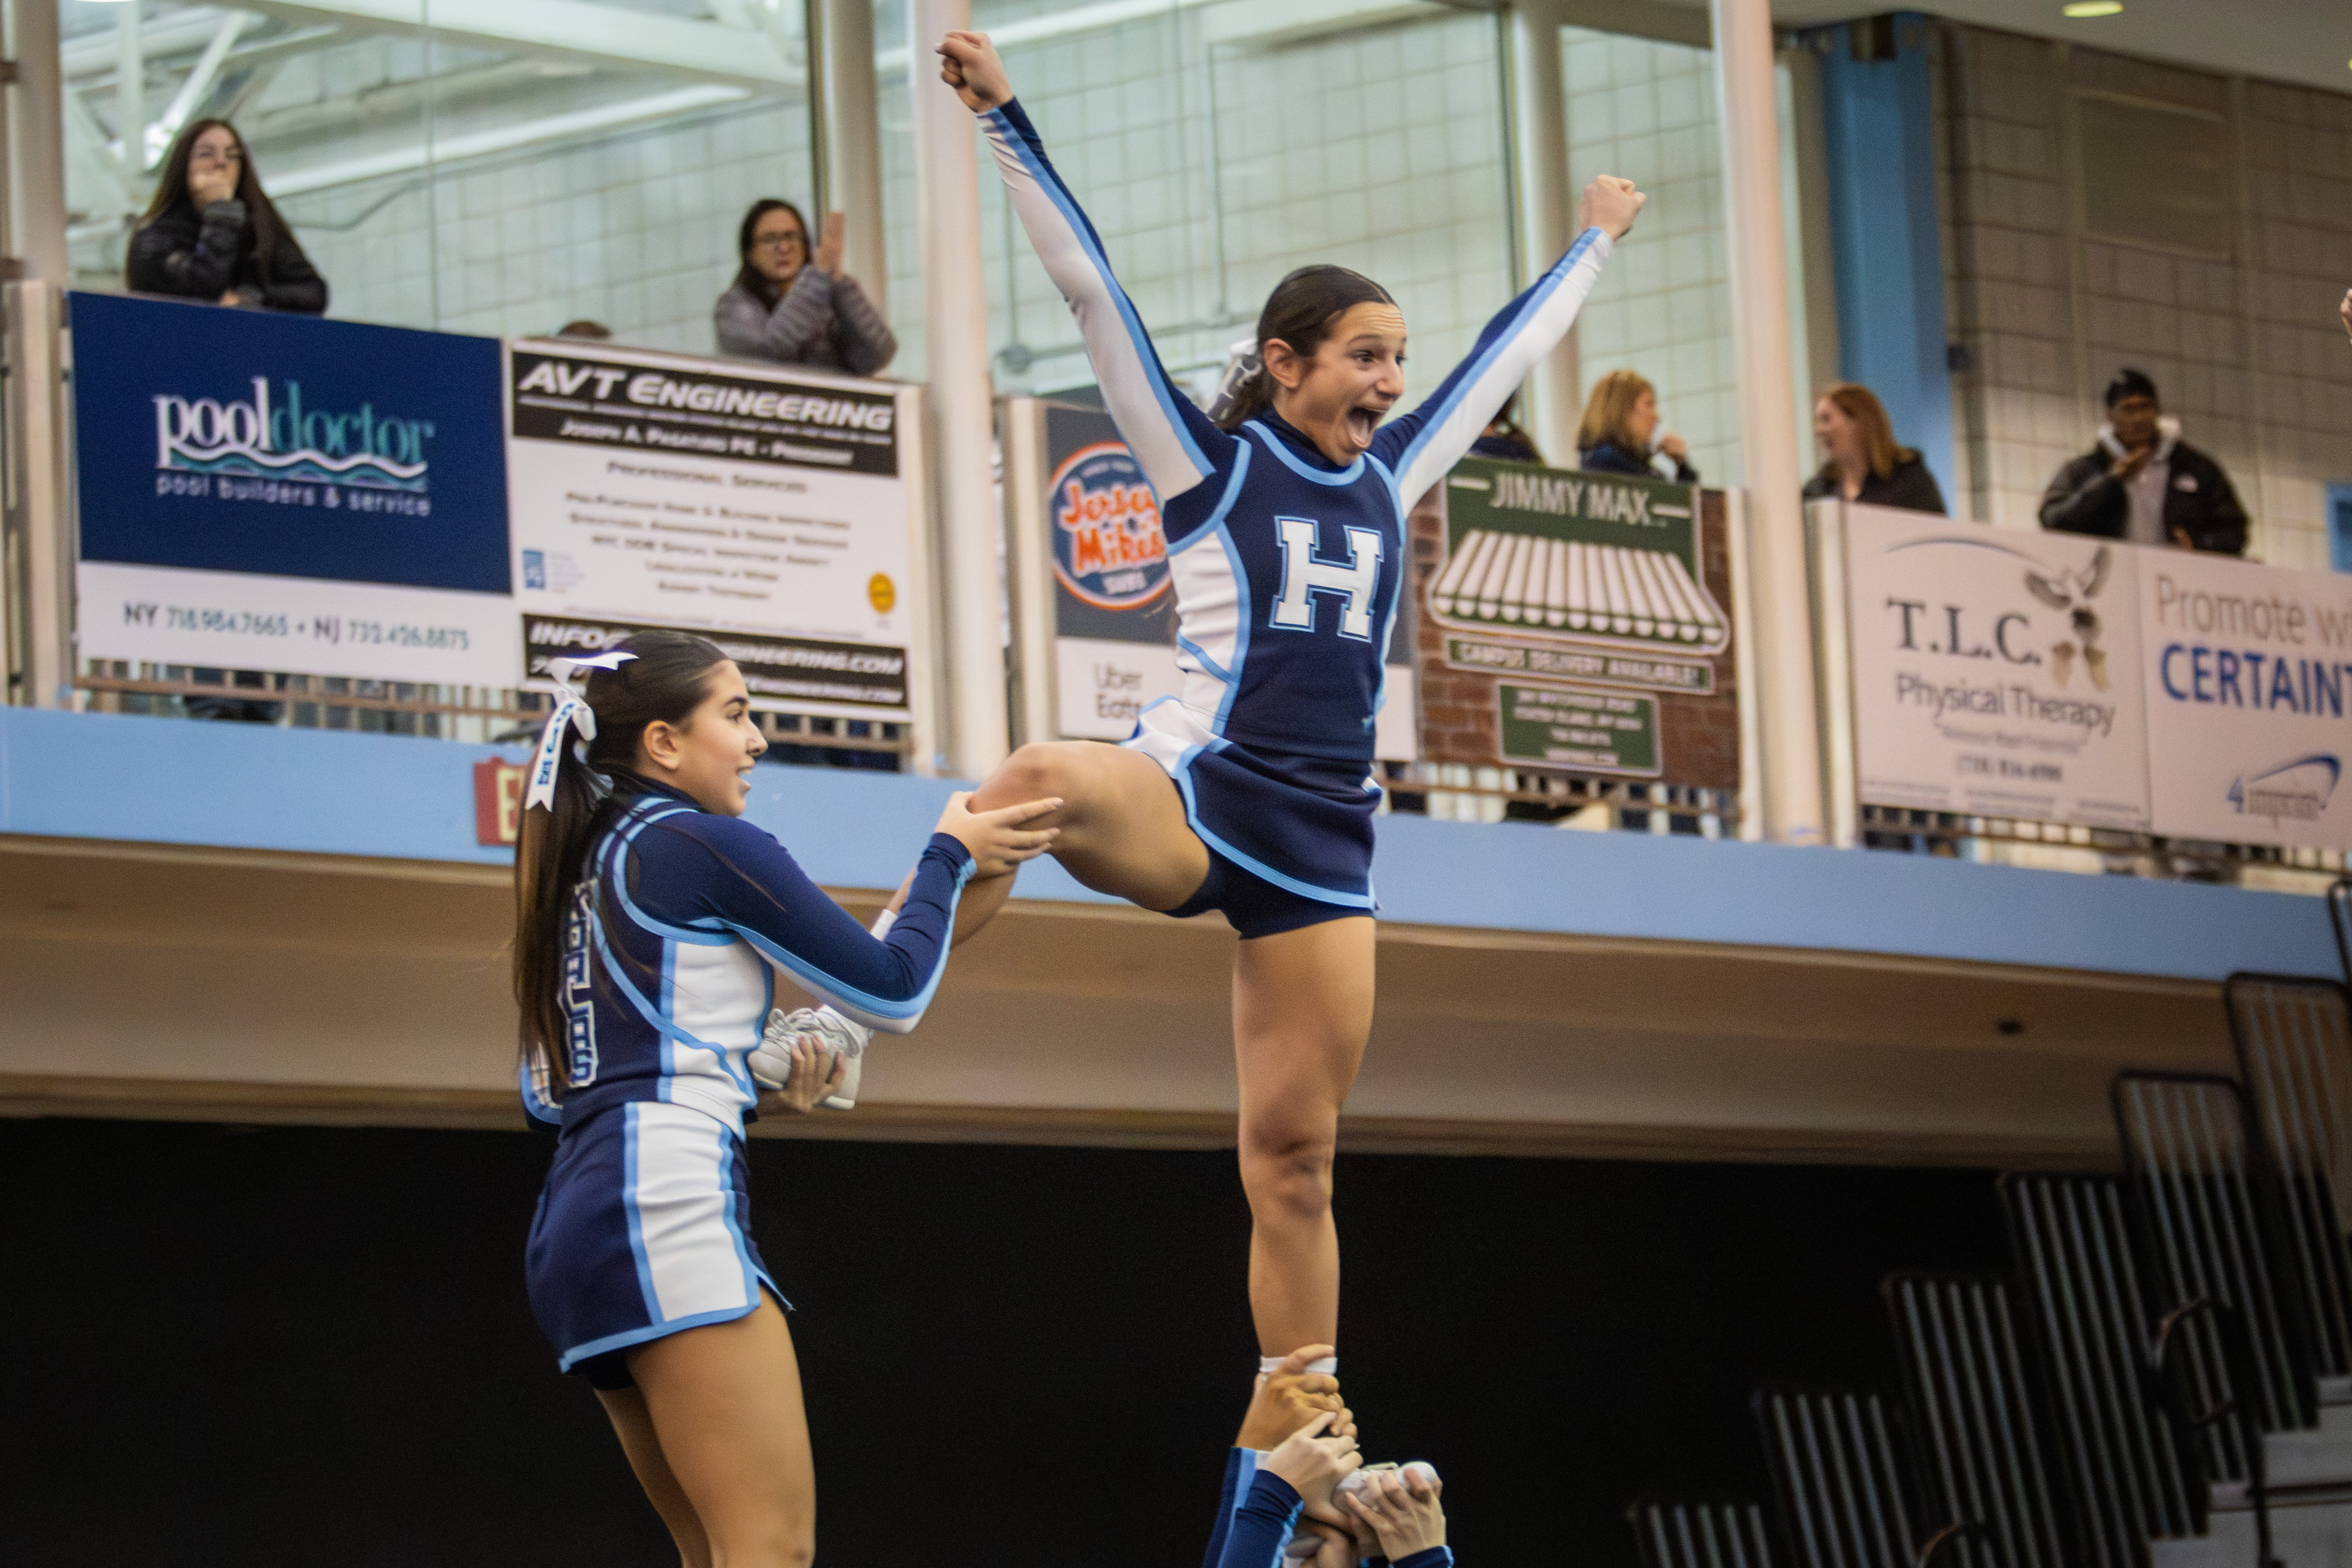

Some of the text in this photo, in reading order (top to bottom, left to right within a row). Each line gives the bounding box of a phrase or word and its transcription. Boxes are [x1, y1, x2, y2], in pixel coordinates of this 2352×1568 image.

[517, 361, 626, 400] AVT
[627, 373, 893, 431] ENGINEERING
[156, 473, 430, 517] pool builders & service
[1491, 472, 1652, 526] JIMMY MAX
[1269, 516, 1383, 643] H
[2156, 573, 2305, 646] Promote
[124, 602, 158, 627] NY
[314, 616, 341, 645] NJ
[1886, 595, 2042, 667] T.L.C.
[1093, 662, 1143, 690] Uber
[1895, 672, 2115, 737] Physical Therapy
